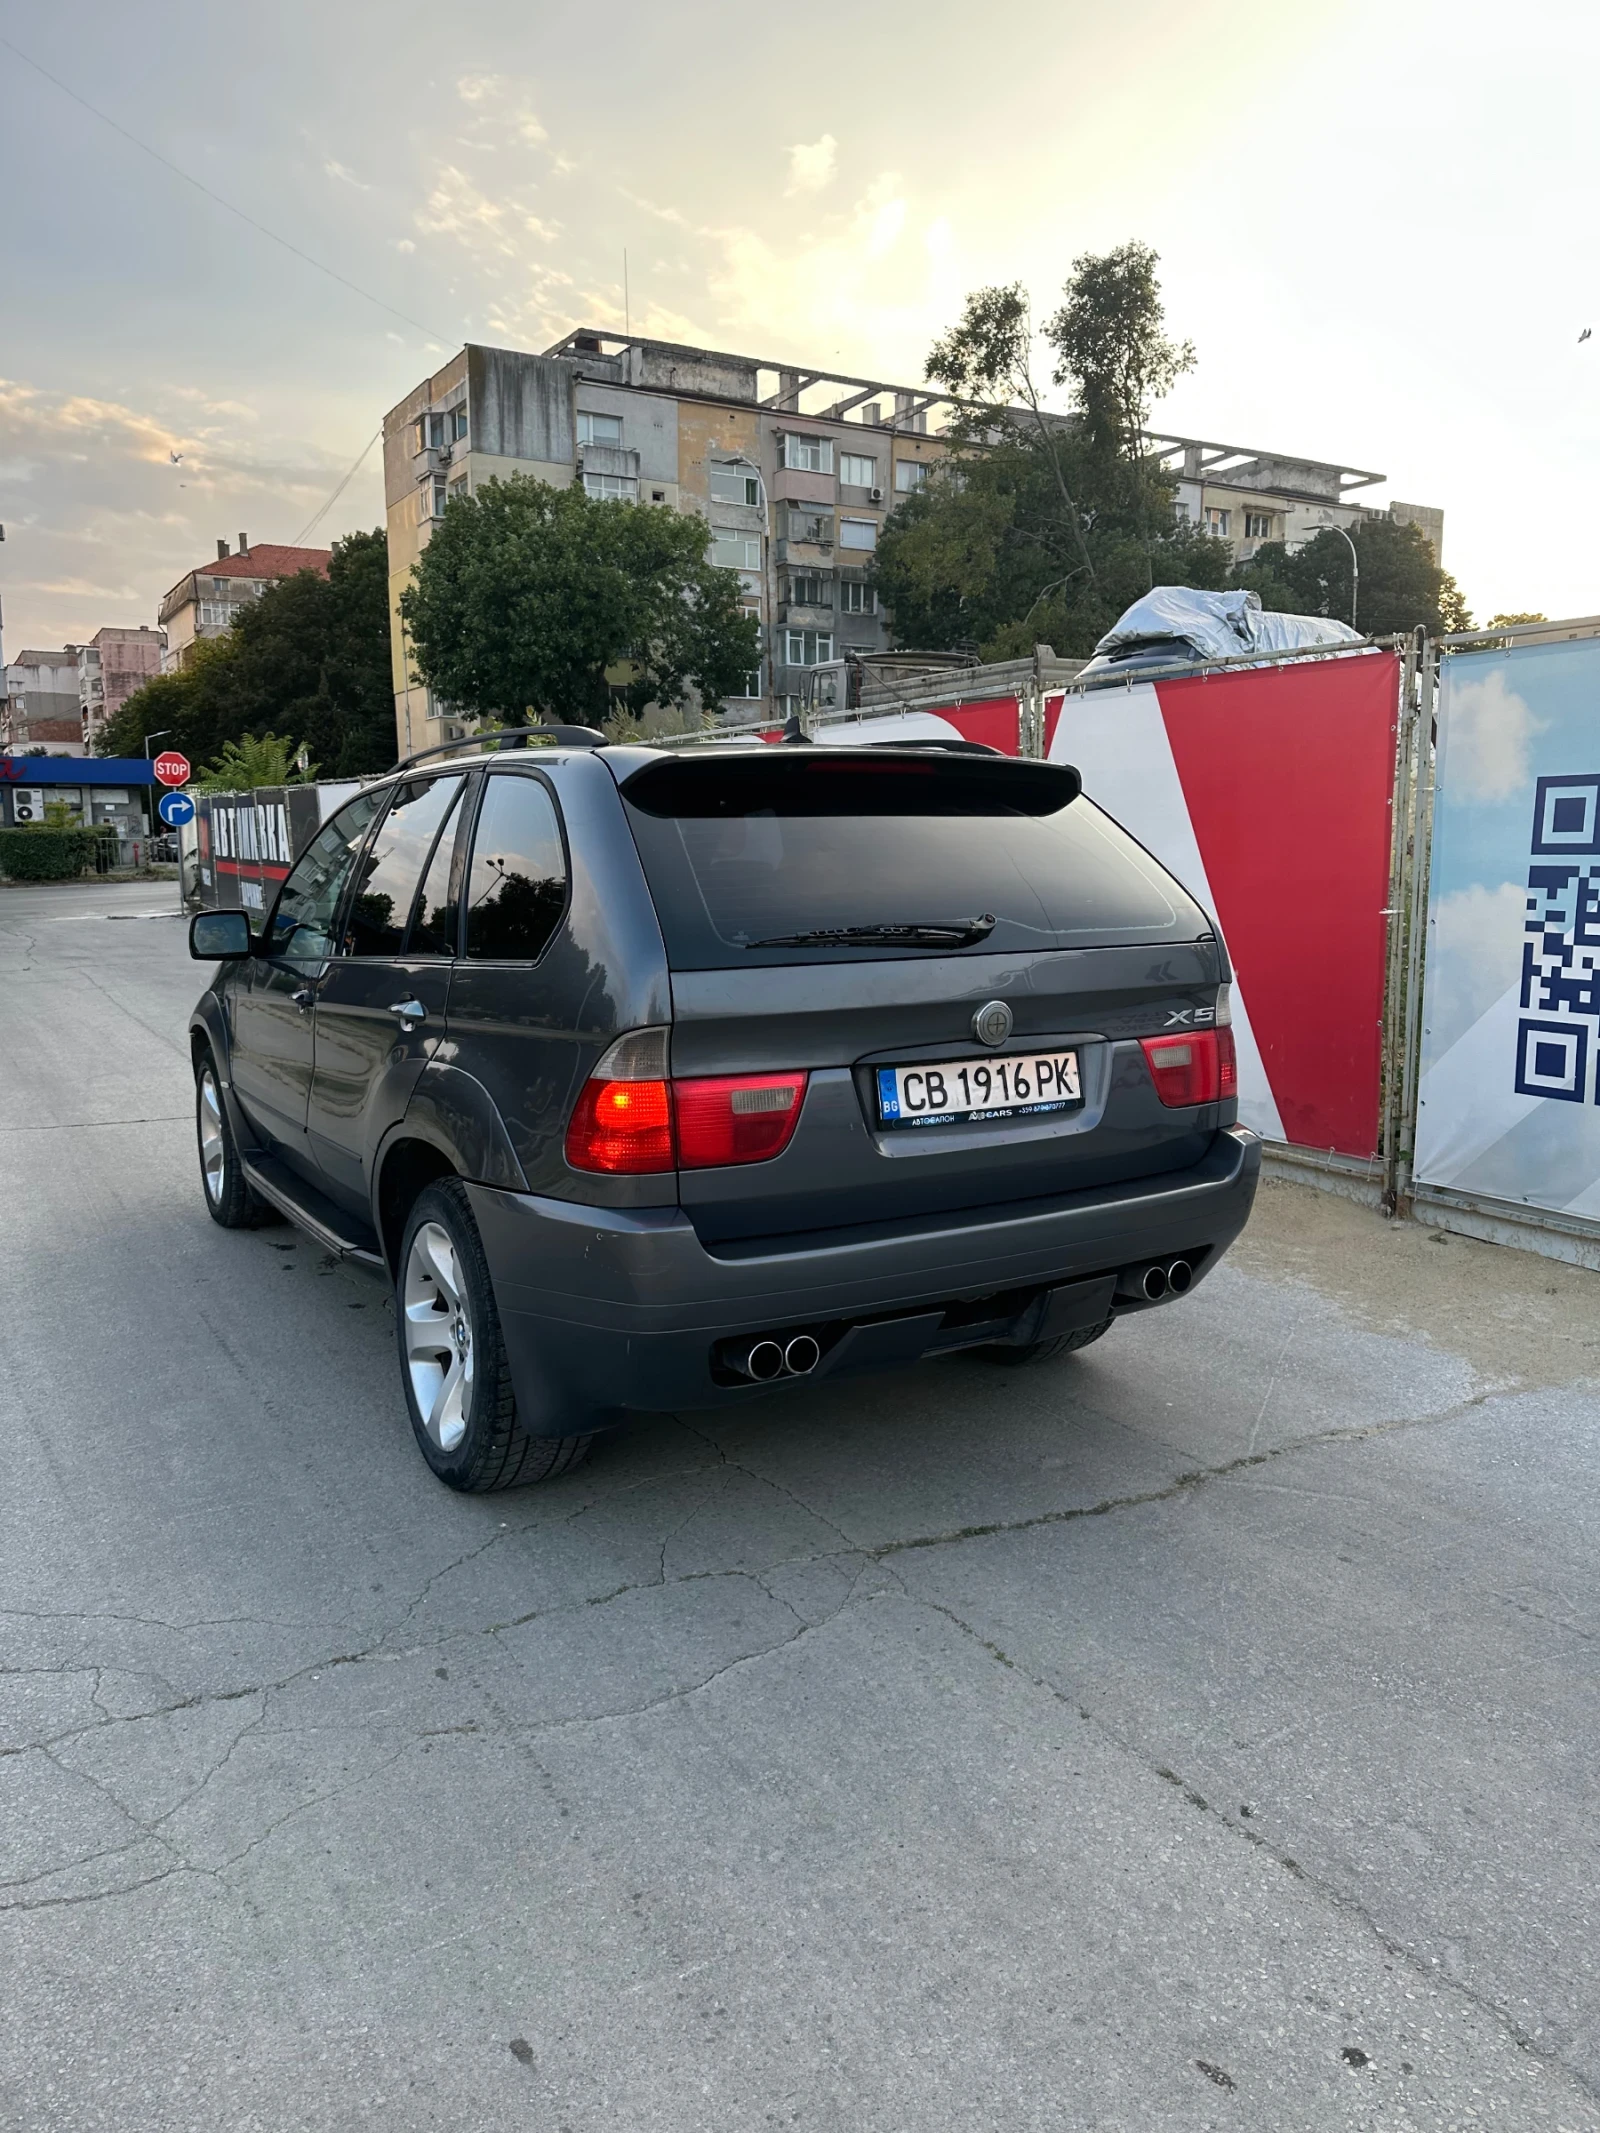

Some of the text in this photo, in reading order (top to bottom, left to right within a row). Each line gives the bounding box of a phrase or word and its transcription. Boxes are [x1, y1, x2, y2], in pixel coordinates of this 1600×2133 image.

[157, 762, 187, 775] STOP
[1163, 1006, 1215, 1027] X5
[903, 1071, 949, 1111] CB
[957, 1062, 1031, 1105] 1916
[1034, 1057, 1074, 1097] PK
[883, 1101, 898, 1112] BG
